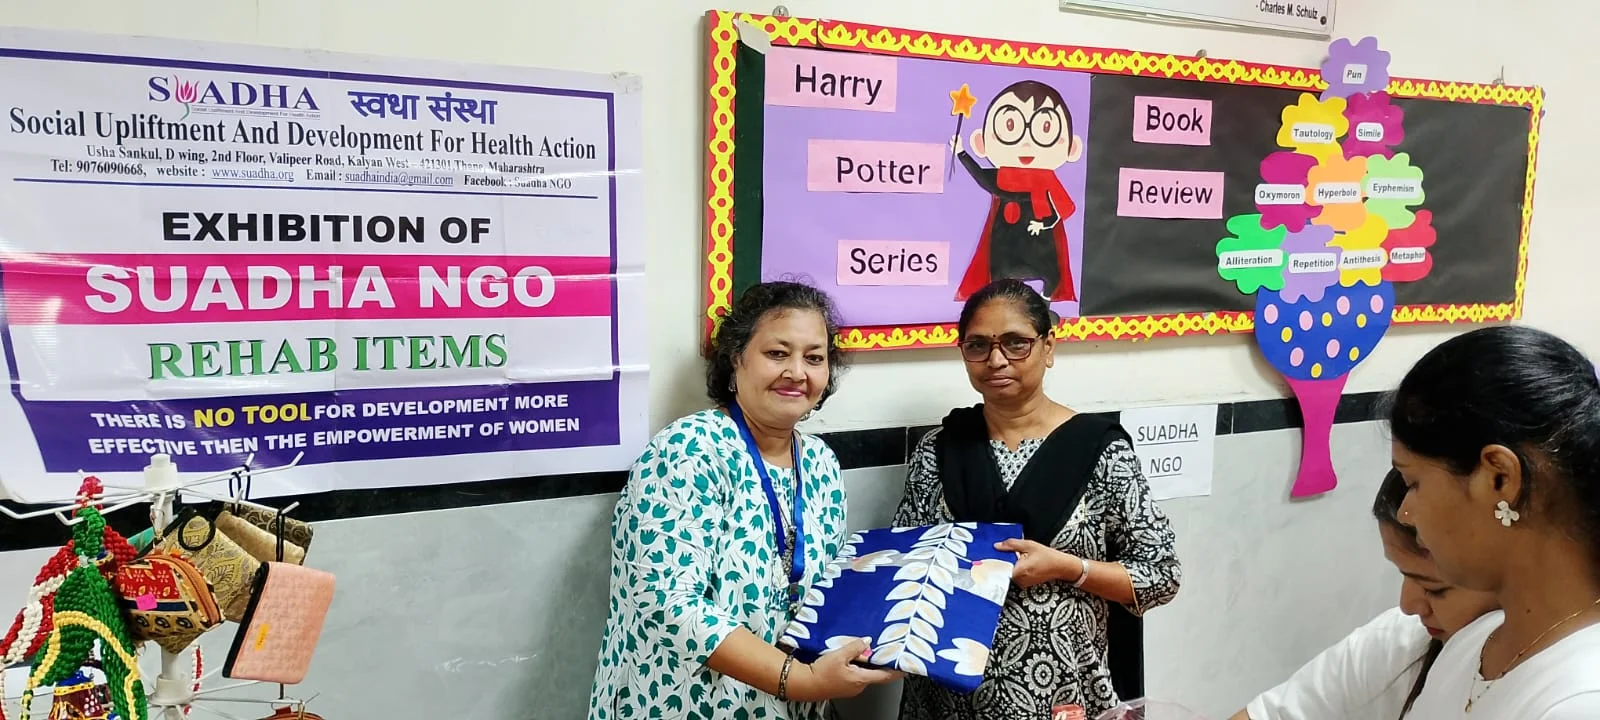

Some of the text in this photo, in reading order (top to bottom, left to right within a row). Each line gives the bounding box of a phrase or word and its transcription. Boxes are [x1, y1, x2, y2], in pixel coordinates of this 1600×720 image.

[1260, 0, 1285, 15] Charles
[1287, 3, 1295, 16] M.
[1296, 4, 1318, 20] Schulz
[794, 64, 882, 105] Harry
[1346, 70, 1362, 79] Pun
[348, 91, 498, 125] स्वधा संस्था
[1146, 104, 1204, 133] Book
[10, 107, 85, 136] Social
[95, 111, 226, 145] Upliftment
[232, 119, 279, 144] And
[287, 121, 423, 155] Development
[430, 129, 465, 153] For
[471, 131, 534, 157] Health
[539, 135, 596, 160] Action
[1293, 128, 1334, 140] Tautology
[1358, 128, 1381, 138] Simile
[87, 145, 116, 158] Usha
[119, 146, 162, 161] Sankul,
[166, 148, 175, 160] D
[178, 149, 208, 164] wing,
[211, 150, 232, 162] 2nd
[235, 151, 266, 164] Floor,
[269, 152, 312, 167] Valipeer
[315, 154, 345, 167] Road,
[347, 155, 383, 169] Kalyan
[385, 157, 409, 168] West
[488, 161, 545, 174] Maharashtra
[836, 156, 930, 186] Potter
[50, 159, 73, 172] Tel:
[76, 160, 147, 177] 9076090668,
[157, 165, 198, 177] website
[212, 168, 294, 182] www.suadha.org
[306, 169, 336, 181] Email
[345, 170, 454, 187] suadhaindia@gmail.com
[550, 178, 572, 189] NGO
[1128, 180, 1213, 205] Review
[1258, 189, 1300, 201] Oxymoron
[1317, 188, 1357, 199] Hyperbole
[1373, 183, 1415, 194] Eyphemism
[162, 211, 491, 244] EXHIBITION OF
[849, 247, 938, 275] Series
[1225, 255, 1273, 265] Alliteration
[1293, 257, 1334, 268] Repetition
[1343, 254, 1381, 265] Antithesis
[1391, 251, 1425, 262] Metaphor
[85, 264, 556, 313] SUADHA NGO
[147, 333, 508, 380] REHAB ITEMS
[90, 394, 568, 429] THERE IS NO TOOL FOR DEVELOPMENT MORE
[88, 418, 580, 456] EFFECTIVE THEN THE EMPOWERMENT OF WOMEN
[1137, 423, 1199, 442] SUADHA
[1150, 456, 1182, 474] NGO
